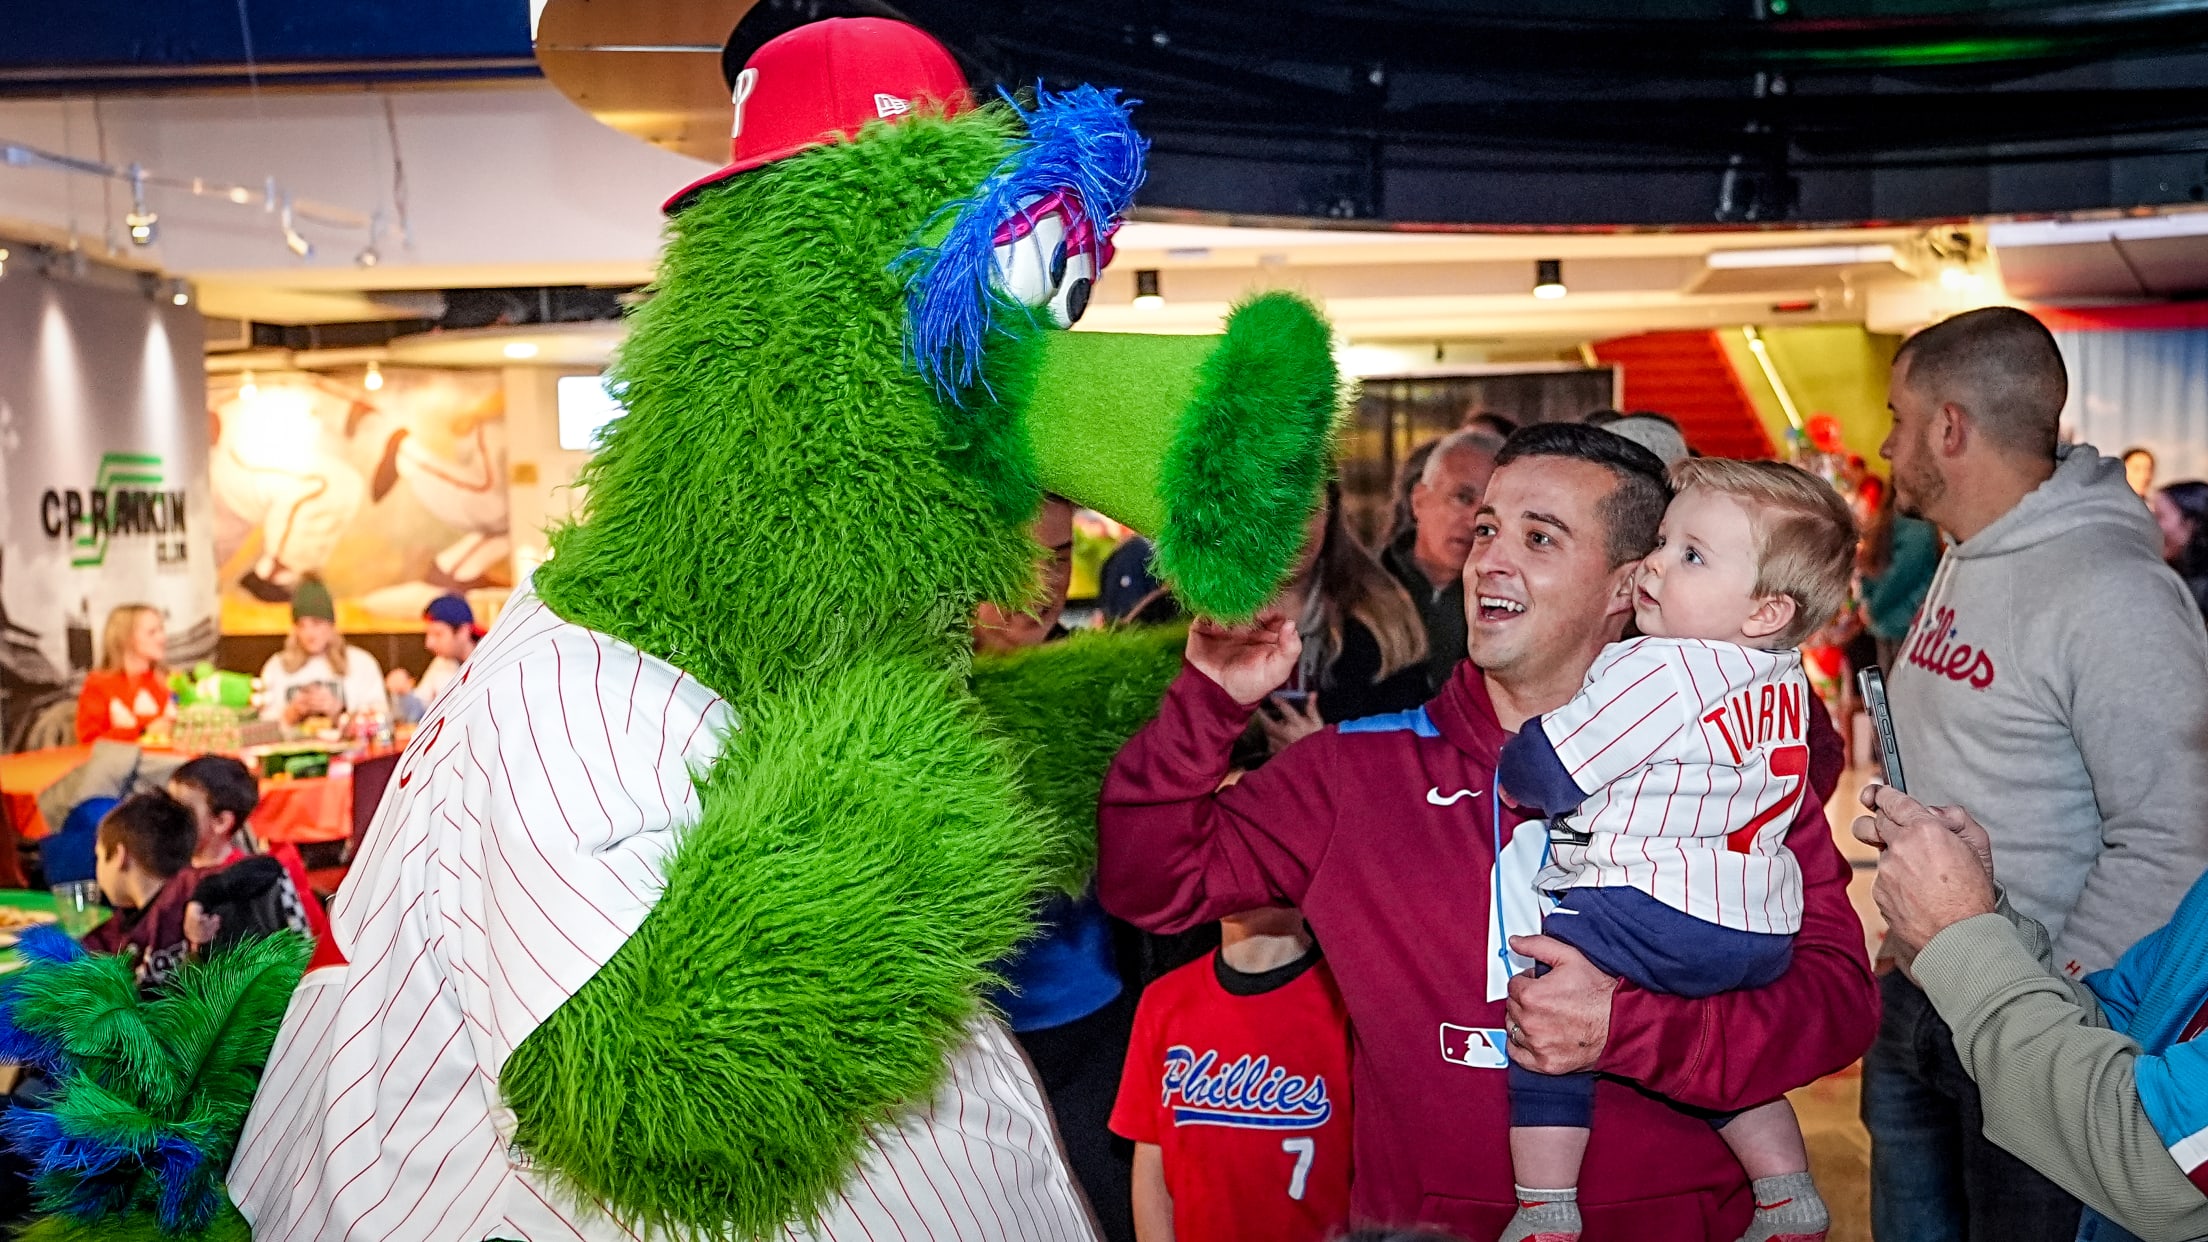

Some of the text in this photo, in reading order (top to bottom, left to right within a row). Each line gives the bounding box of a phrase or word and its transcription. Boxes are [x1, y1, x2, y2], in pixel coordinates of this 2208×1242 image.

[731, 67, 760, 139] P
[1901, 604, 1995, 689] illies
[1727, 744, 1809, 856] 7
[1162, 1045, 1332, 1126] Phillies
[1281, 1137, 1315, 1200] 7
